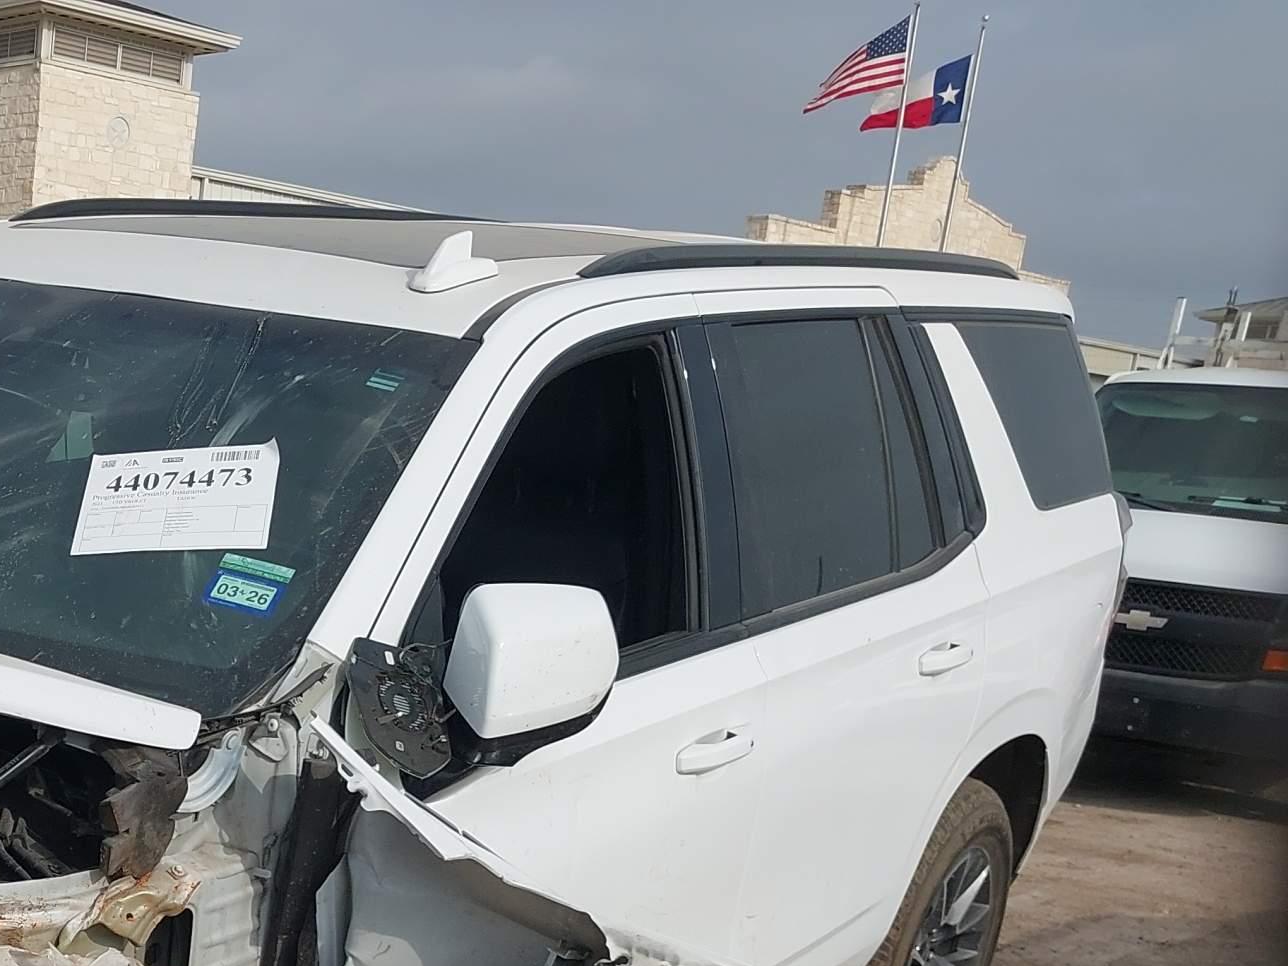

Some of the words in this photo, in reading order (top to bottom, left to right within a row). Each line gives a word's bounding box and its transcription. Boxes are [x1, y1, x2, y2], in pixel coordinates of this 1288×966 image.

[106, 467, 252, 493] 44074473
[92, 493, 134, 501] Progressive
[172, 488, 209, 496] Insurance
[217, 583, 239, 597] 03
[245, 590, 270, 605] 26
